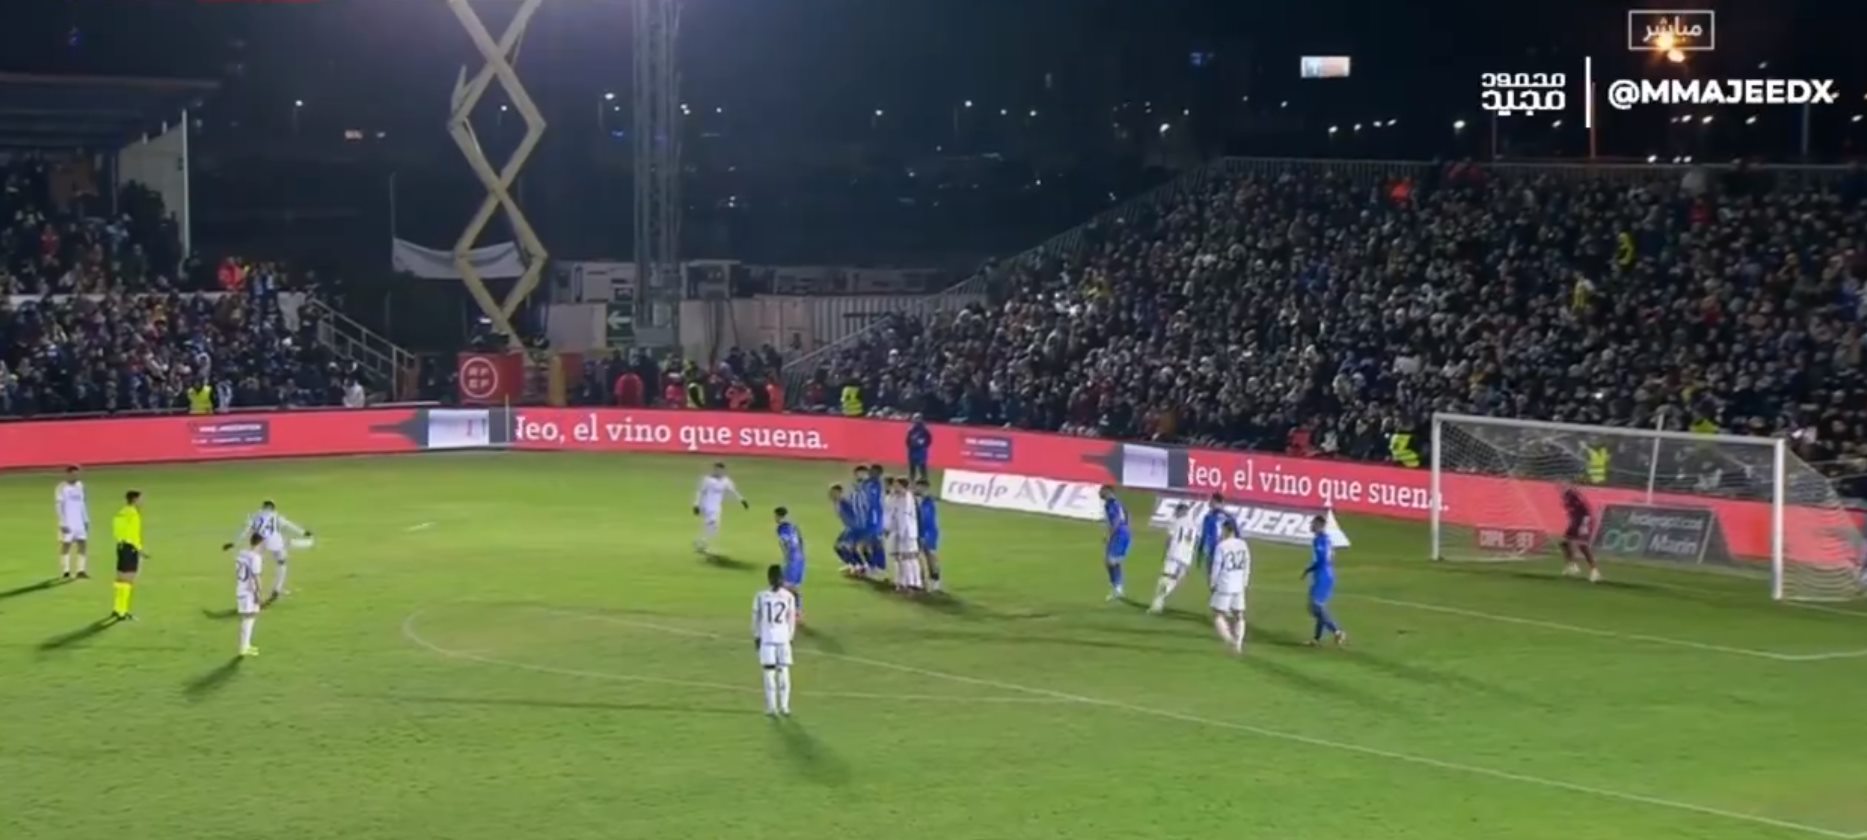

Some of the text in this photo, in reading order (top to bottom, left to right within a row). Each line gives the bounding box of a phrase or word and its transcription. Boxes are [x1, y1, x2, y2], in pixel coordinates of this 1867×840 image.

[573, 413, 598, 441] el
[605, 416, 672, 442] vino
[679, 425, 732, 451] que
[739, 427, 829, 449] suena.
[948, 475, 1089, 511] renfe AVE
[1233, 459, 1253, 490] el
[1259, 464, 1312, 496] vino
[1318, 477, 1362, 507] que
[1225, 549, 1246, 571] 32
[764, 600, 786, 624] 12
